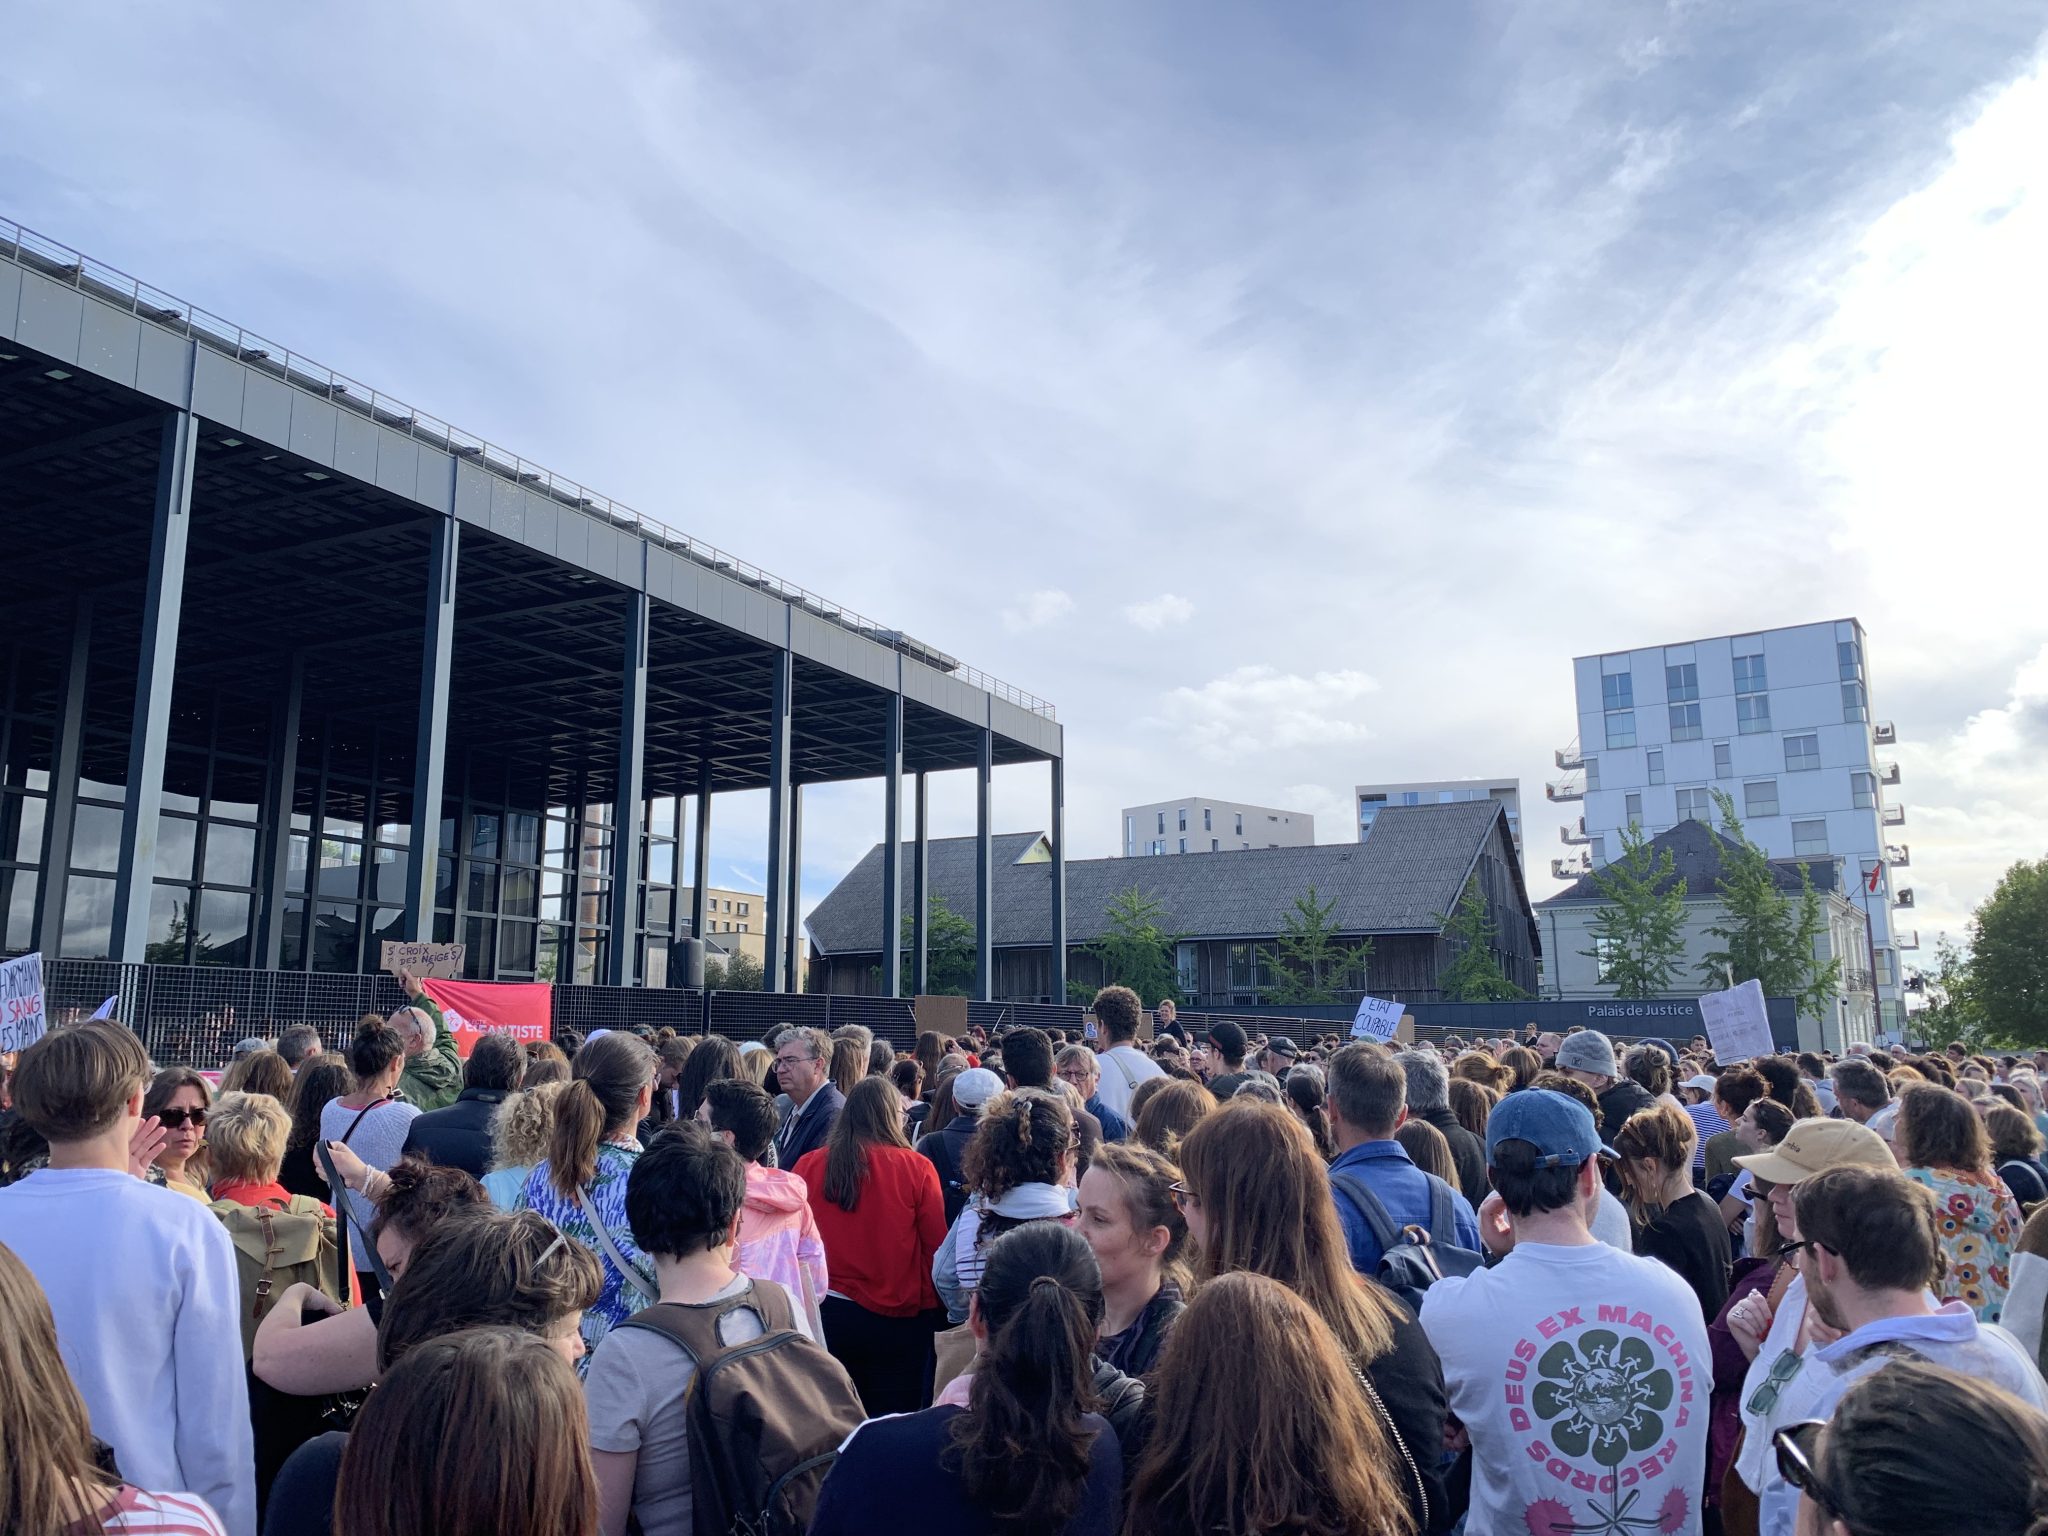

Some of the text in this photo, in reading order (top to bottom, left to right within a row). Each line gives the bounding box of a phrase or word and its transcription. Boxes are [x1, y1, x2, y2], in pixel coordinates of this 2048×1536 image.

[399, 957, 417, 966] DES
[8, 994, 41, 1023] SANG
[1368, 999, 1394, 1014] ETAT
[1588, 1004, 1694, 1017] Palais de Justice
[0, 1013, 43, 1053] ES MAINS
[1354, 1013, 1396, 1038] COUPABLE
[1505, 1304, 1695, 1432] DEUS EX MACHINA
[1526, 1438, 1678, 1494] RECORDS
